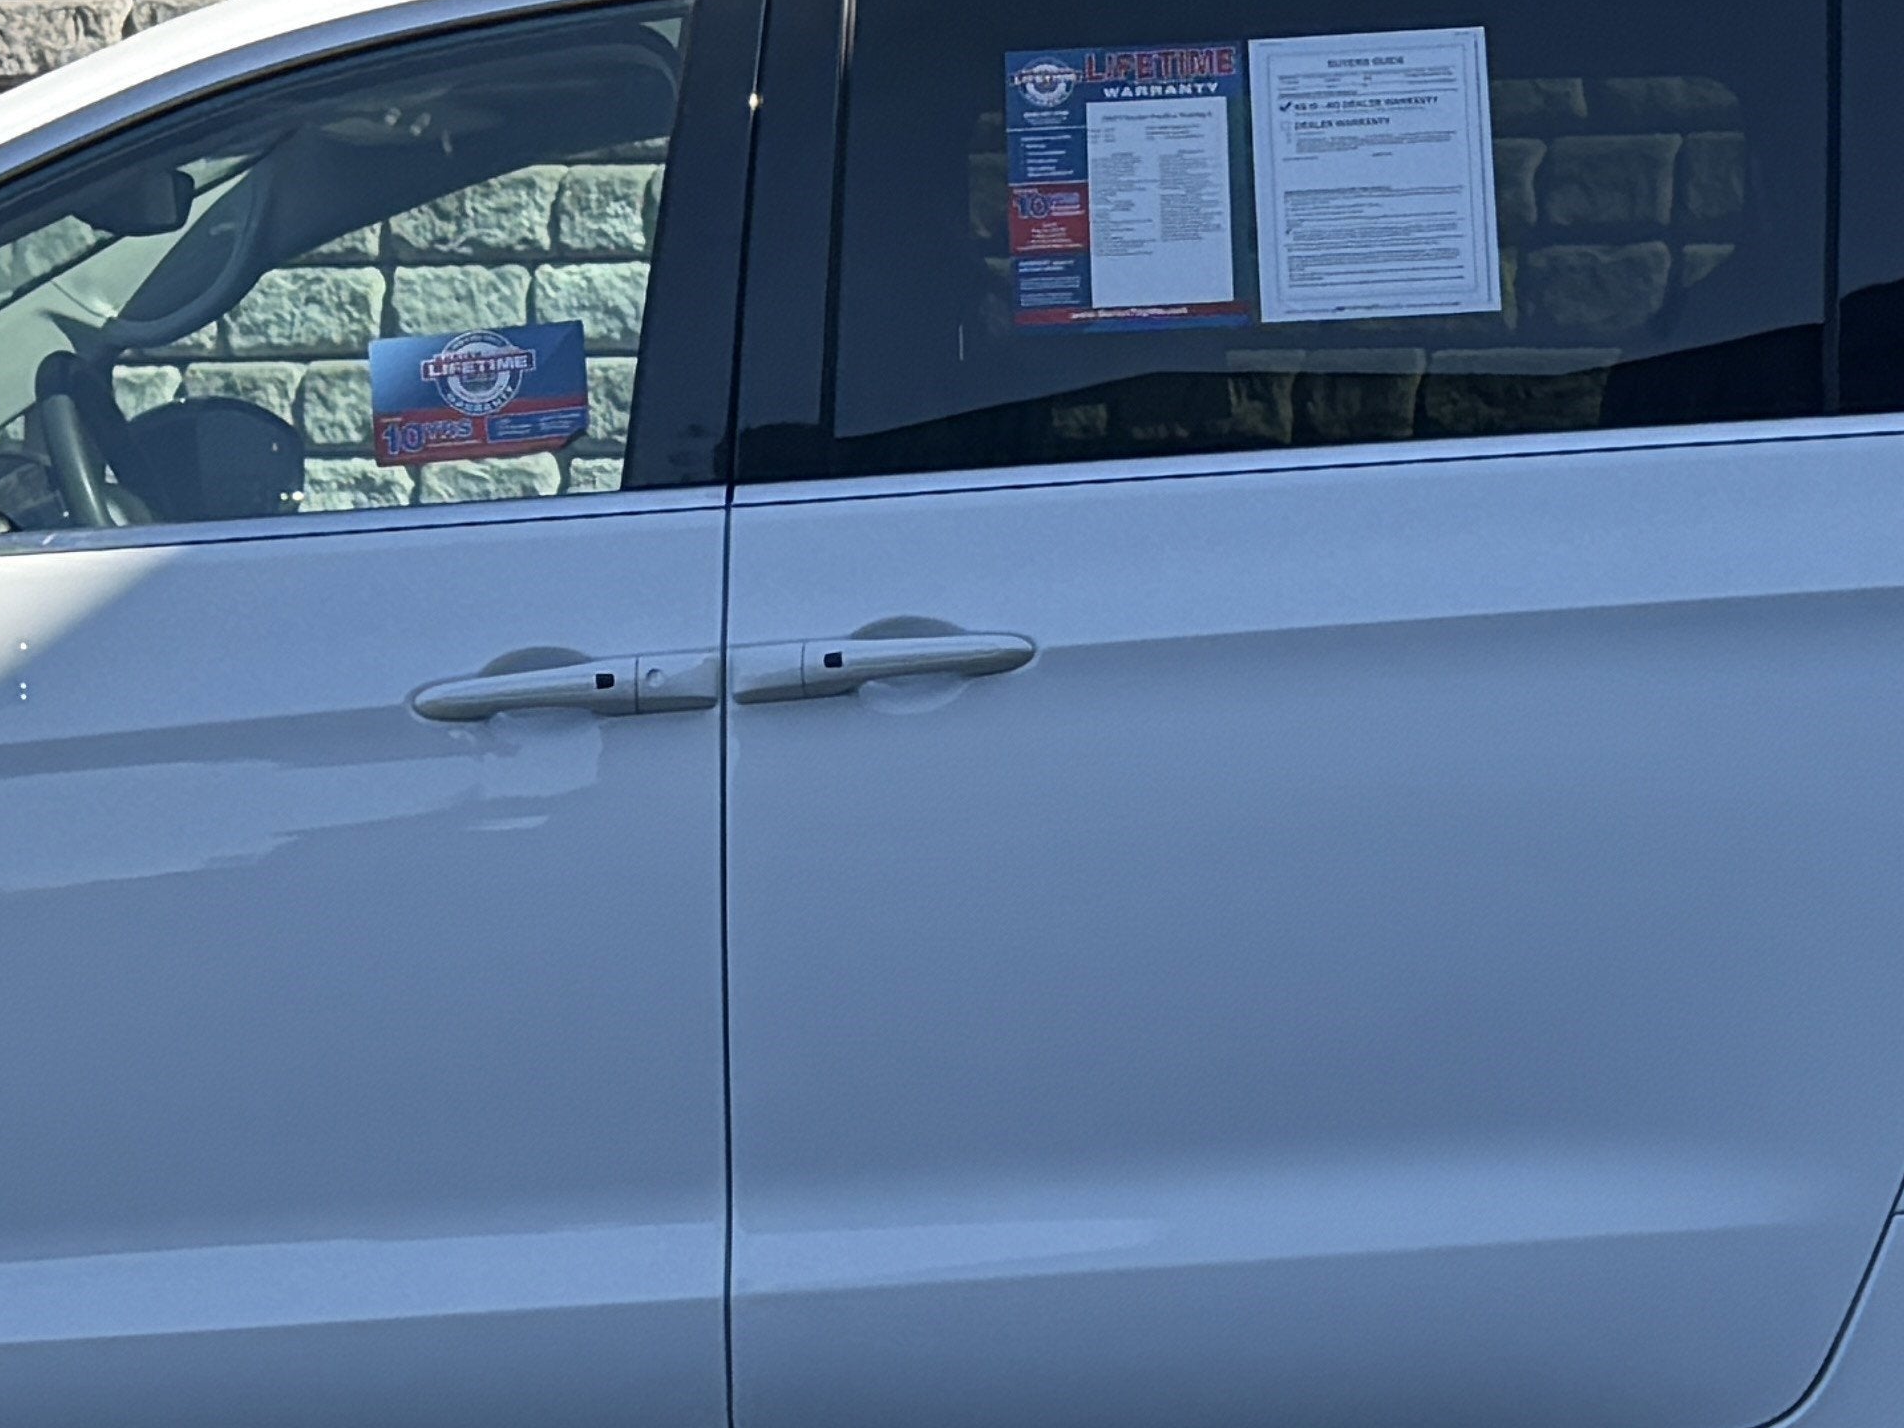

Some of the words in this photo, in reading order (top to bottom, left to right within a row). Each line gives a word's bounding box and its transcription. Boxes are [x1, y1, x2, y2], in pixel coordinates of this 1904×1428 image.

[1083, 46, 1237, 83] LIFETIME
[1102, 81, 1219, 99] WARRANTY
[427, 354, 529, 377] LIFETIME
[382, 421, 426, 456] 10
